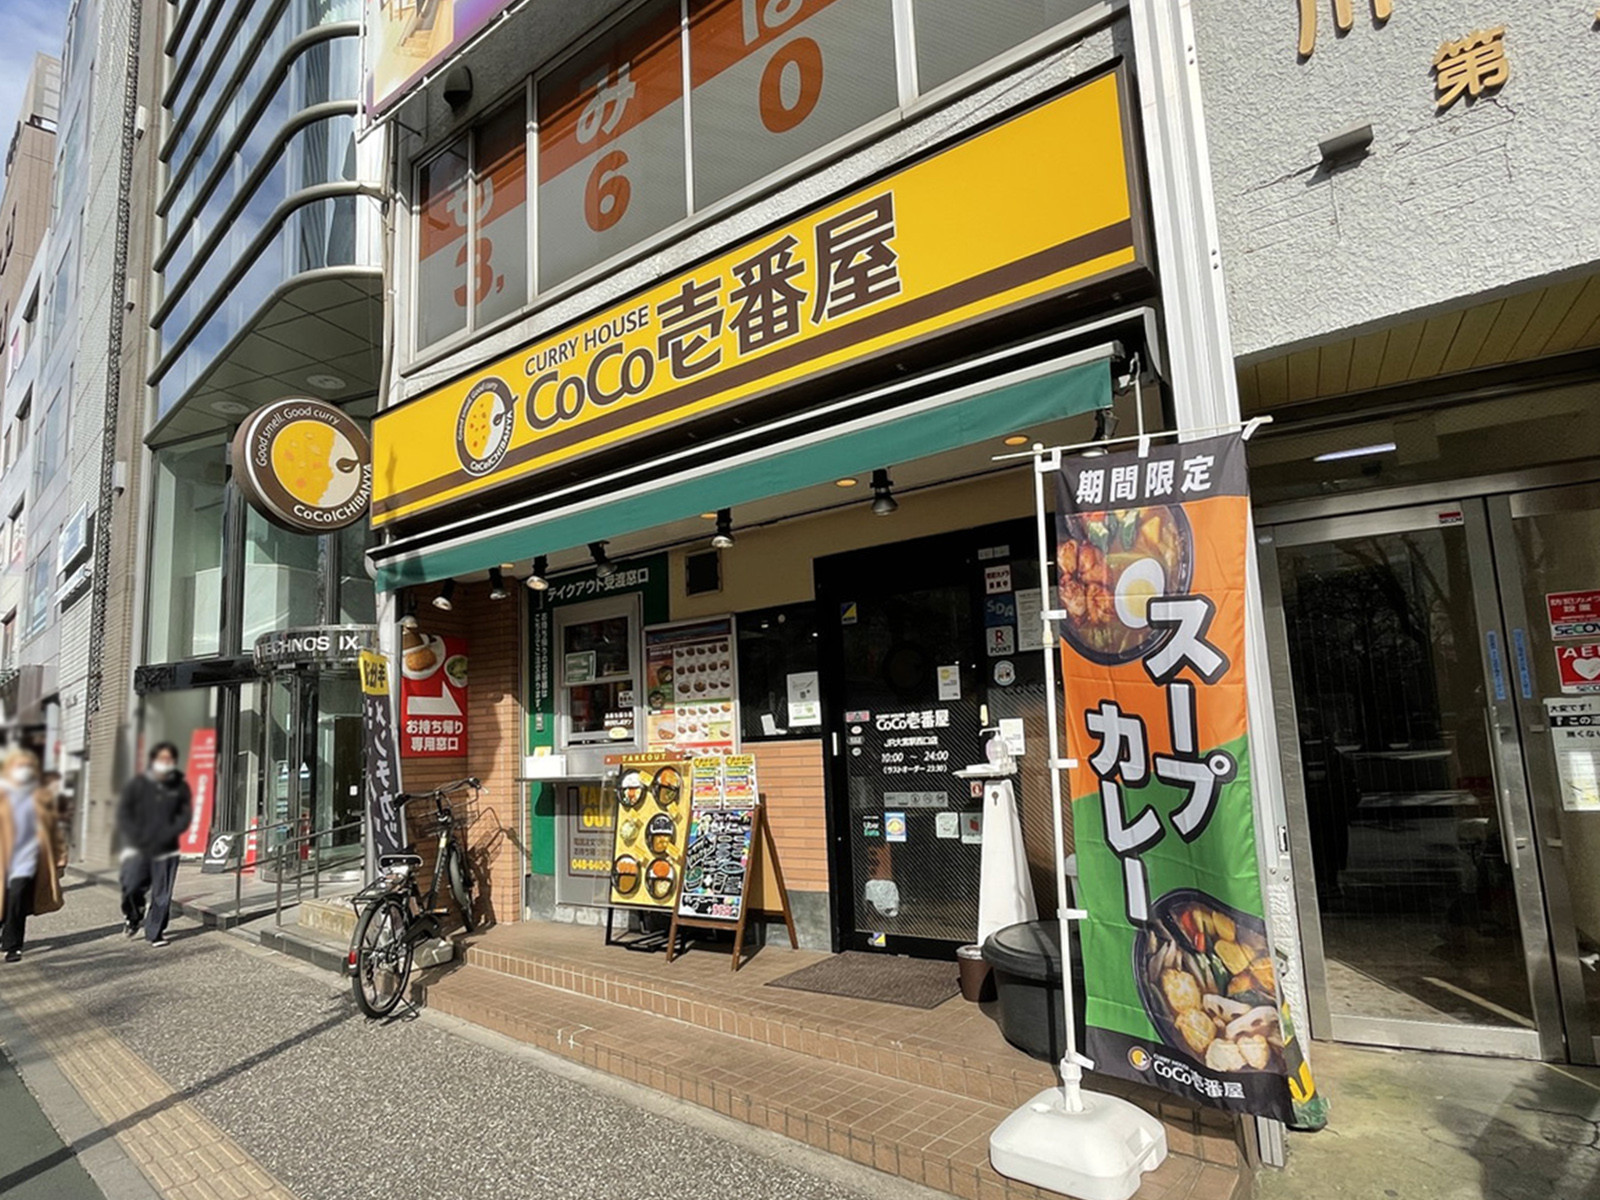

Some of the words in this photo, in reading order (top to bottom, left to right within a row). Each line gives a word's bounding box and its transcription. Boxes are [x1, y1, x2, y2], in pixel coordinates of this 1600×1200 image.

[1433, 25, 1510, 107] 第
[525, 191, 902, 431] CoCo壱番屋
[524, 337, 578, 377] CURRY
[584, 304, 649, 355] HOUSE
[255, 435, 267, 467] Good
[283, 406, 312, 420] Good
[313, 408, 341, 425] curry
[1075, 454, 1215, 505] 期間限定
[260, 636, 330, 656] TECHNOS
[340, 635, 359, 650] IX
[1562, 645, 1600, 658] AE
[406, 719, 464, 734] お持ち帰り
[876, 709, 950, 731] CoCo壱番屋
[1144, 595, 1235, 839] スープ
[411, 736, 459, 752] 専用窓口
[881, 752, 904, 763] 10:00
[923, 750, 949, 761] 24:00
[1085, 700, 1162, 923] カレー
[1153, 1060, 1246, 1099] CoCo壱番屋
